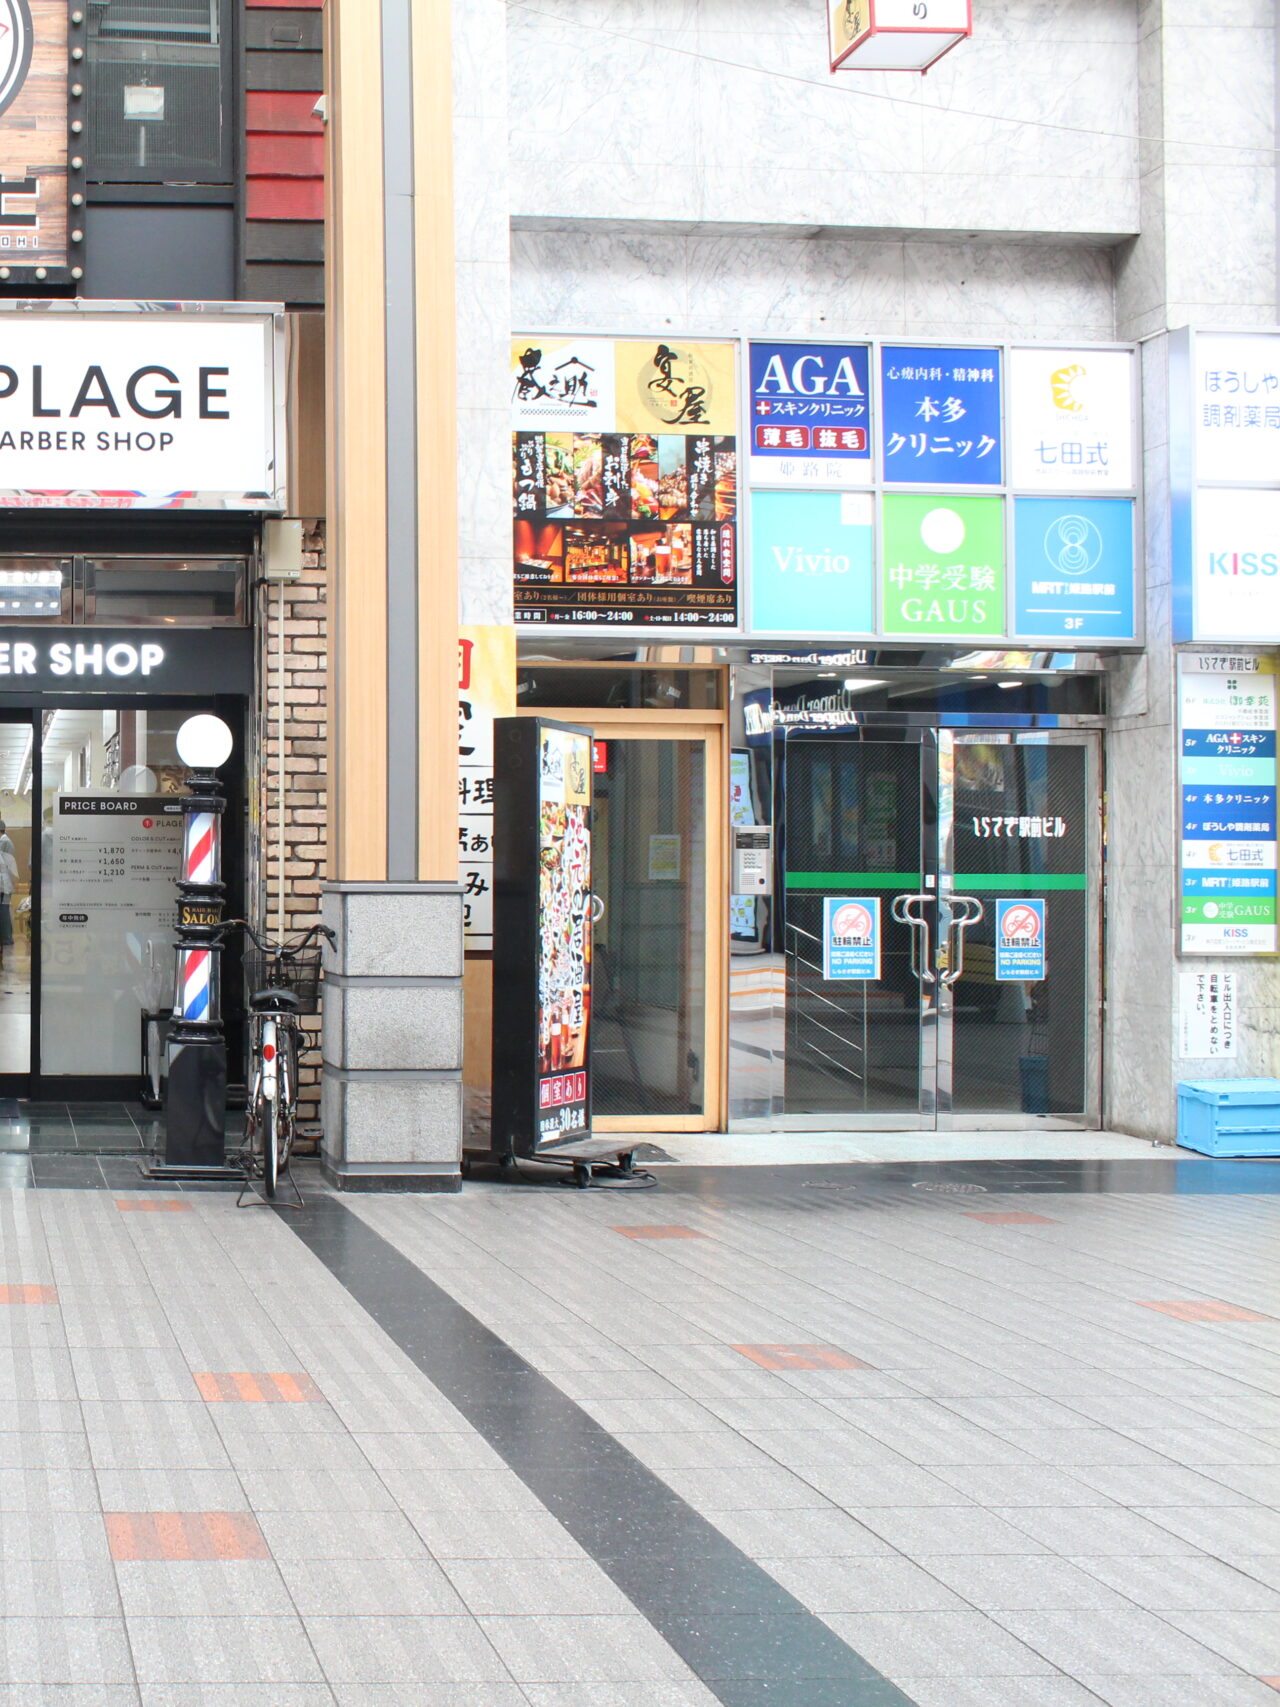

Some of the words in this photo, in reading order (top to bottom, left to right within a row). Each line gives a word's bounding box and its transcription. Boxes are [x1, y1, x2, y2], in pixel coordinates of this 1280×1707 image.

[648, 344, 710, 425] 宴屋
[756, 354, 864, 396] AGA
[887, 367, 994, 383] 心療内科・精神科
[1204, 371, 1279, 394] ほうしや
[772, 402, 865, 418] スキンクリニック
[915, 396, 967, 423] 本多
[1203, 404, 1280, 428] 調剤薬局
[97, 431, 174, 451] SHOP
[763, 428, 803, 447] 薄毛
[819, 429, 860, 448] 抜毛
[886, 433, 996, 458] クリニック
[693, 437, 714, 486] 串焼き
[1034, 440, 1109, 466] 七田式
[602, 455, 620, 508] お刺身
[772, 546, 850, 573] Vivio
[1209, 552, 1278, 576] KISS
[889, 562, 997, 591] 中学受験
[900, 598, 987, 623] GAUS
[1064, 618, 1084, 629] 3F
[49, 643, 165, 676] SHOP
[1185, 738, 1198, 747] 5F
[1206, 733, 1229, 743] AGA
[1242, 733, 1266, 744] スキン
[1217, 744, 1257, 755] クリニック
[64, 802, 96, 810] PRICE
[100, 802, 138, 811] BOARD
[1185, 795, 1197, 804] 4F
[1204, 793, 1270, 805] 本多クリニック
[156, 820, 183, 828] PLAGE
[1185, 822, 1198, 831] 4F
[1226, 848, 1265, 862] 七田式
[1185, 878, 1198, 887] 3F
[1234, 904, 1271, 916] GAUS
[832, 935, 872, 947] 駐輪禁止
[1001, 936, 1040, 948] 駐輪禁止
[1224, 929, 1248, 938] KISS
[1000, 958, 1011, 966] NO
[1012, 958, 1042, 966] PARKING
[1196, 974, 1206, 1016] で下さい。
[1209, 974, 1219, 1055] 自転車をとめない
[1223, 974, 1233, 1050] ビル出入口につき
